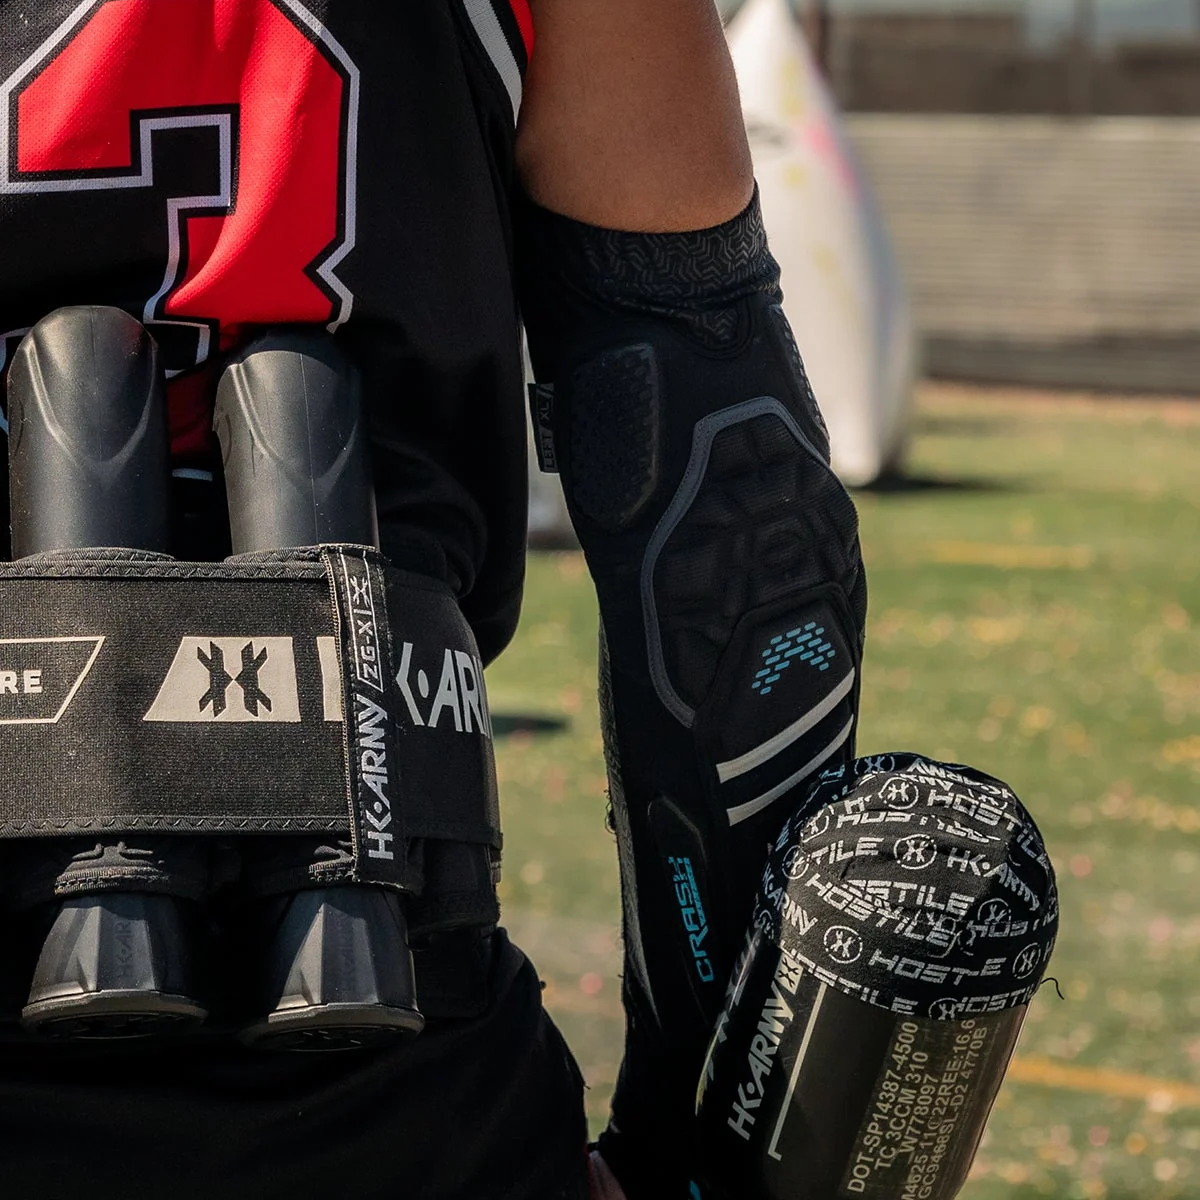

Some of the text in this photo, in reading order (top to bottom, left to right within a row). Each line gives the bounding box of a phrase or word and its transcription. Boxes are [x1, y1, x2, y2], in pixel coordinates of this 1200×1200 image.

[358, 618, 381, 682] ZG-X
[667, 856, 715, 982] CRASH
[847, 1021, 919, 1193] DOT-SP14387-4500
[874, 1051, 929, 1171] TC 3CCM 310
[962, 1026, 988, 1080] 4770B
